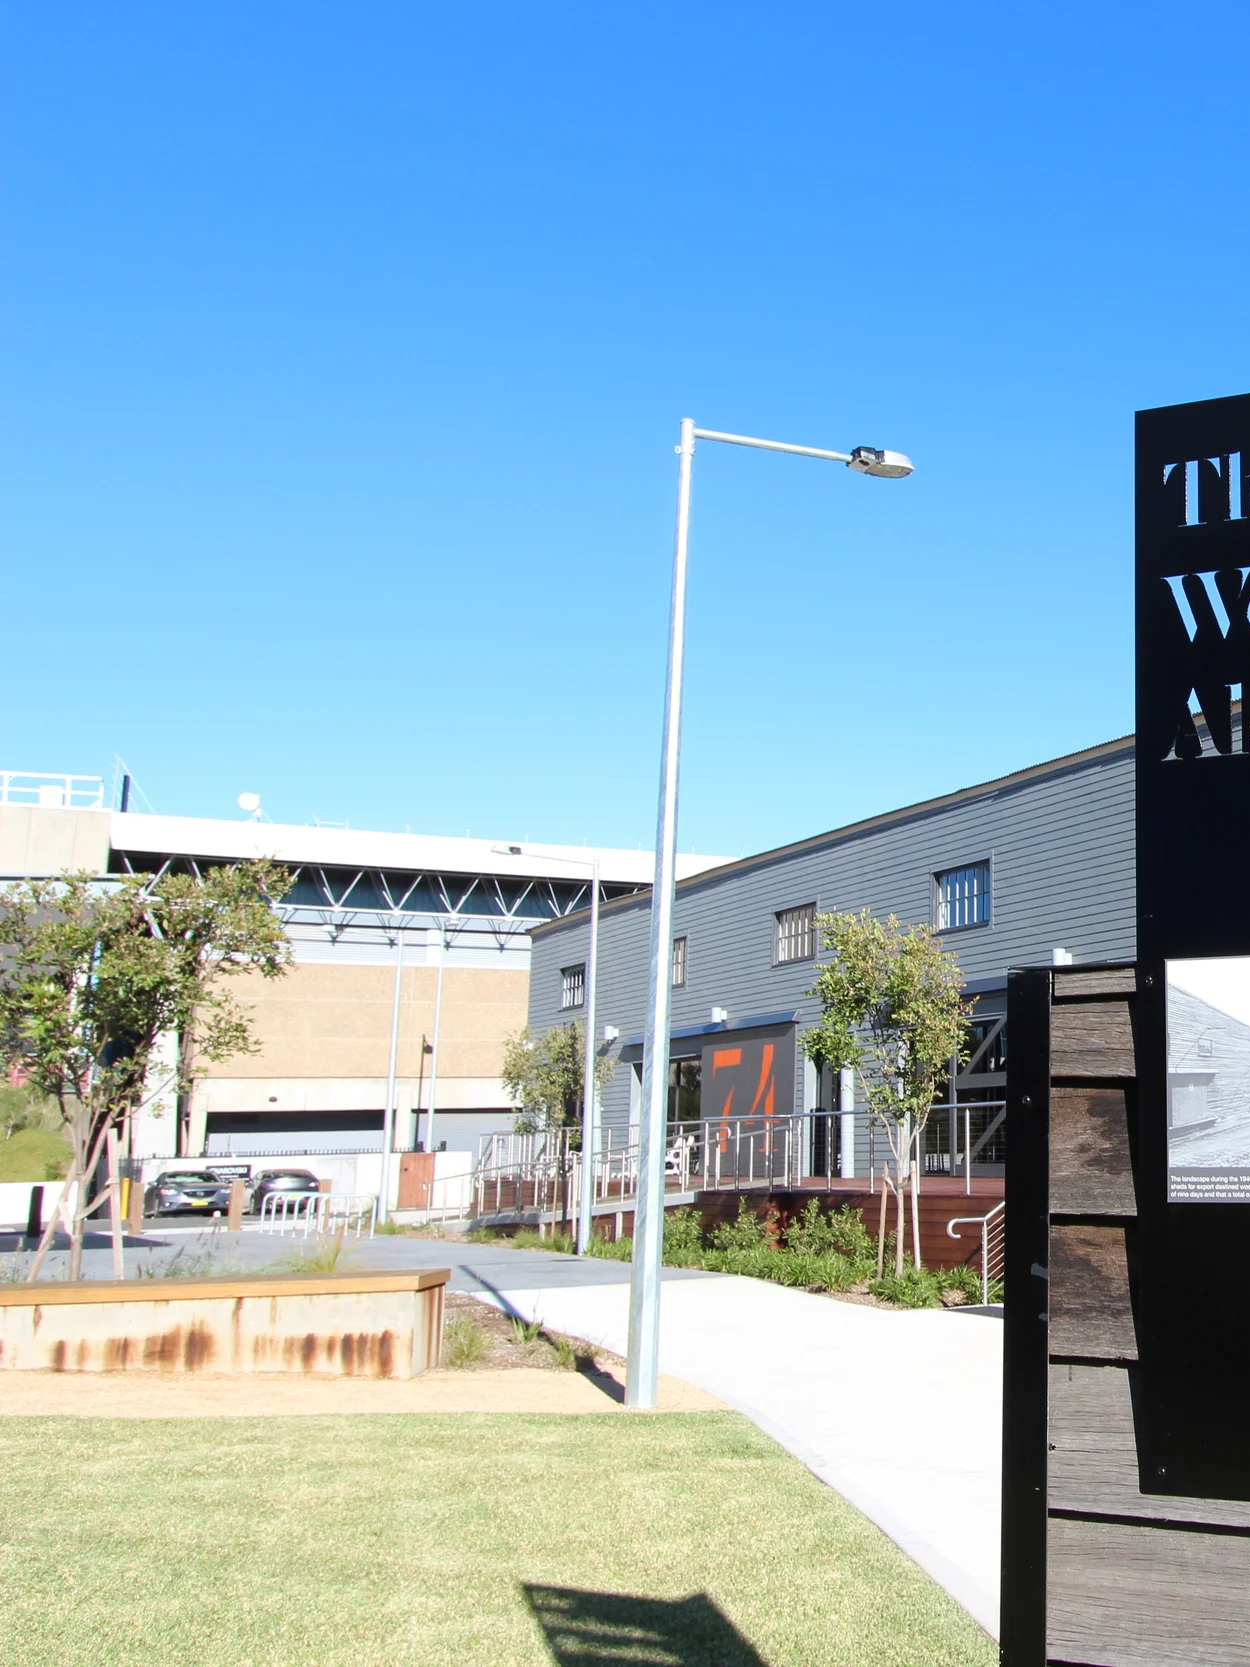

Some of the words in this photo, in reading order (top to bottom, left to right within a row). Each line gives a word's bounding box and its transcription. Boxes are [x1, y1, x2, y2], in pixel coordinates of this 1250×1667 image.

[712, 1044, 779, 1153] 74
[1182, 1175, 1209, 1184] landscape
[1211, 1175, 1228, 1184] during
[1197, 1183, 1214, 1191] export
[1190, 1191, 1203, 1199] days
